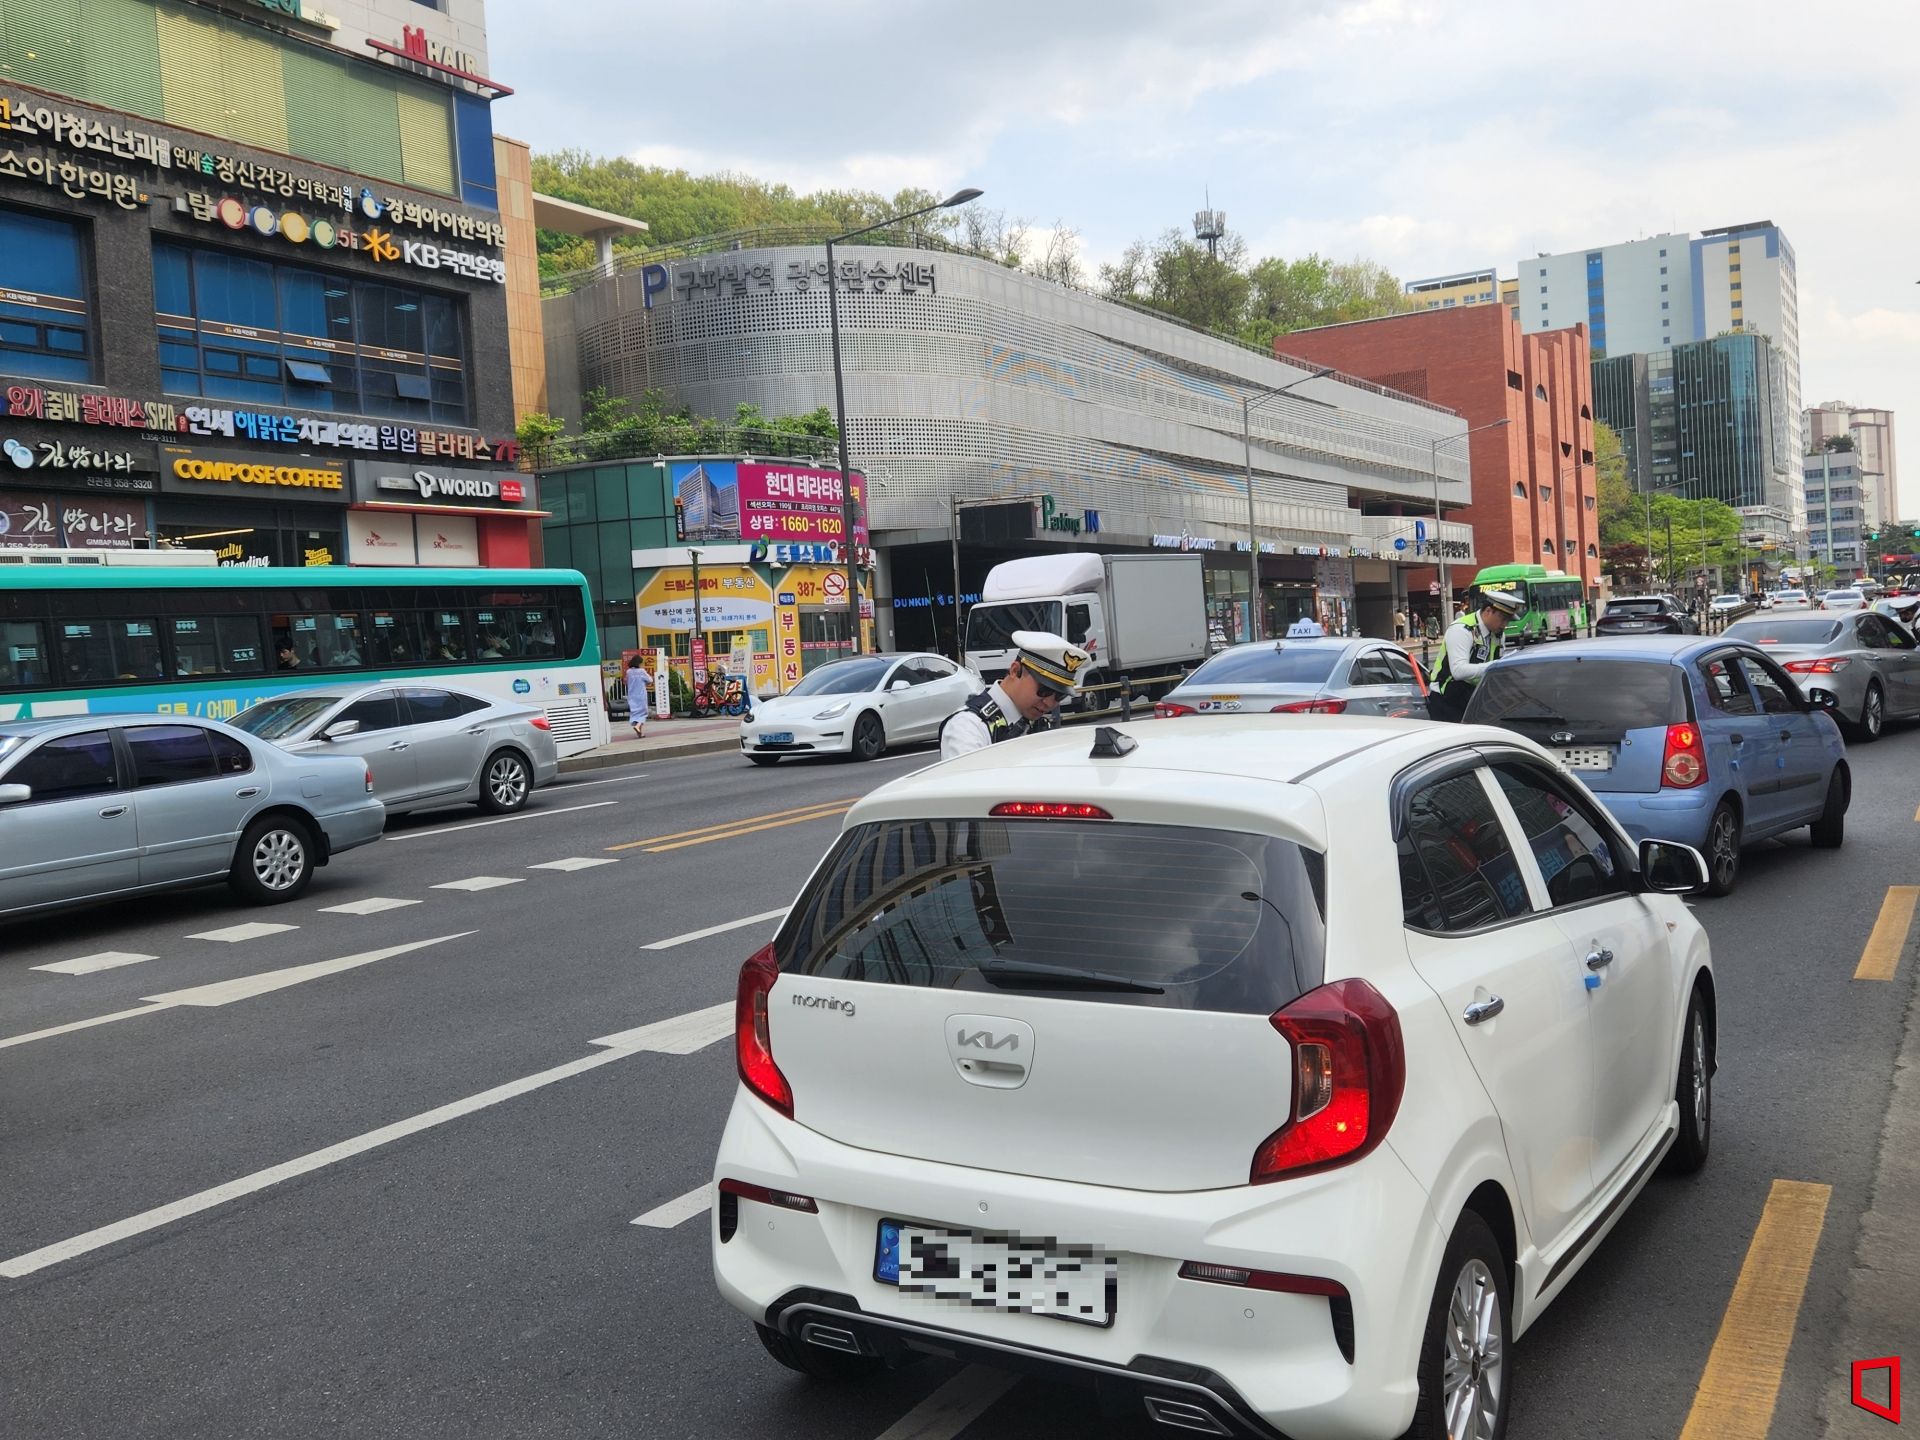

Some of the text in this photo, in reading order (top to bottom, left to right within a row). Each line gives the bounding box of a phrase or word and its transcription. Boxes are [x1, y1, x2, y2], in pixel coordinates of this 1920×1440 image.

[425, 40, 478, 76] HAIR
[189, 192, 214, 222] 탑
[385, 197, 507, 248] 경희아이한의원
[402, 240, 506, 284] KB국민은행
[641, 264, 669, 309] P
[676, 259, 937, 301] 구파발역 광역환승센터
[8, 386, 44, 418] 요가
[46, 391, 79, 422] 줌바
[81, 394, 146, 428] 필라테스
[381, 426, 417, 453] 원업
[418, 431, 491, 460] 필라테스
[174, 459, 343, 490] COMPOSE COFFEE
[438, 478, 494, 497] WORLD
[765, 472, 795, 497] 현대
[750, 515, 779, 530] 상담:
[781, 516, 842, 534] 1660-1620
[1042, 495, 1101, 536] Parking IN
[112, 539, 131, 547] NARA
[1188, 537, 1216, 550] DONUTS
[1236, 540, 1276, 553] OLIVE YOUNG
[722, 577, 755, 589] 부동산
[1292, 627, 1311, 635] TAXI
[207, 699, 237, 719] 어깨
[791, 992, 856, 1017] morning
